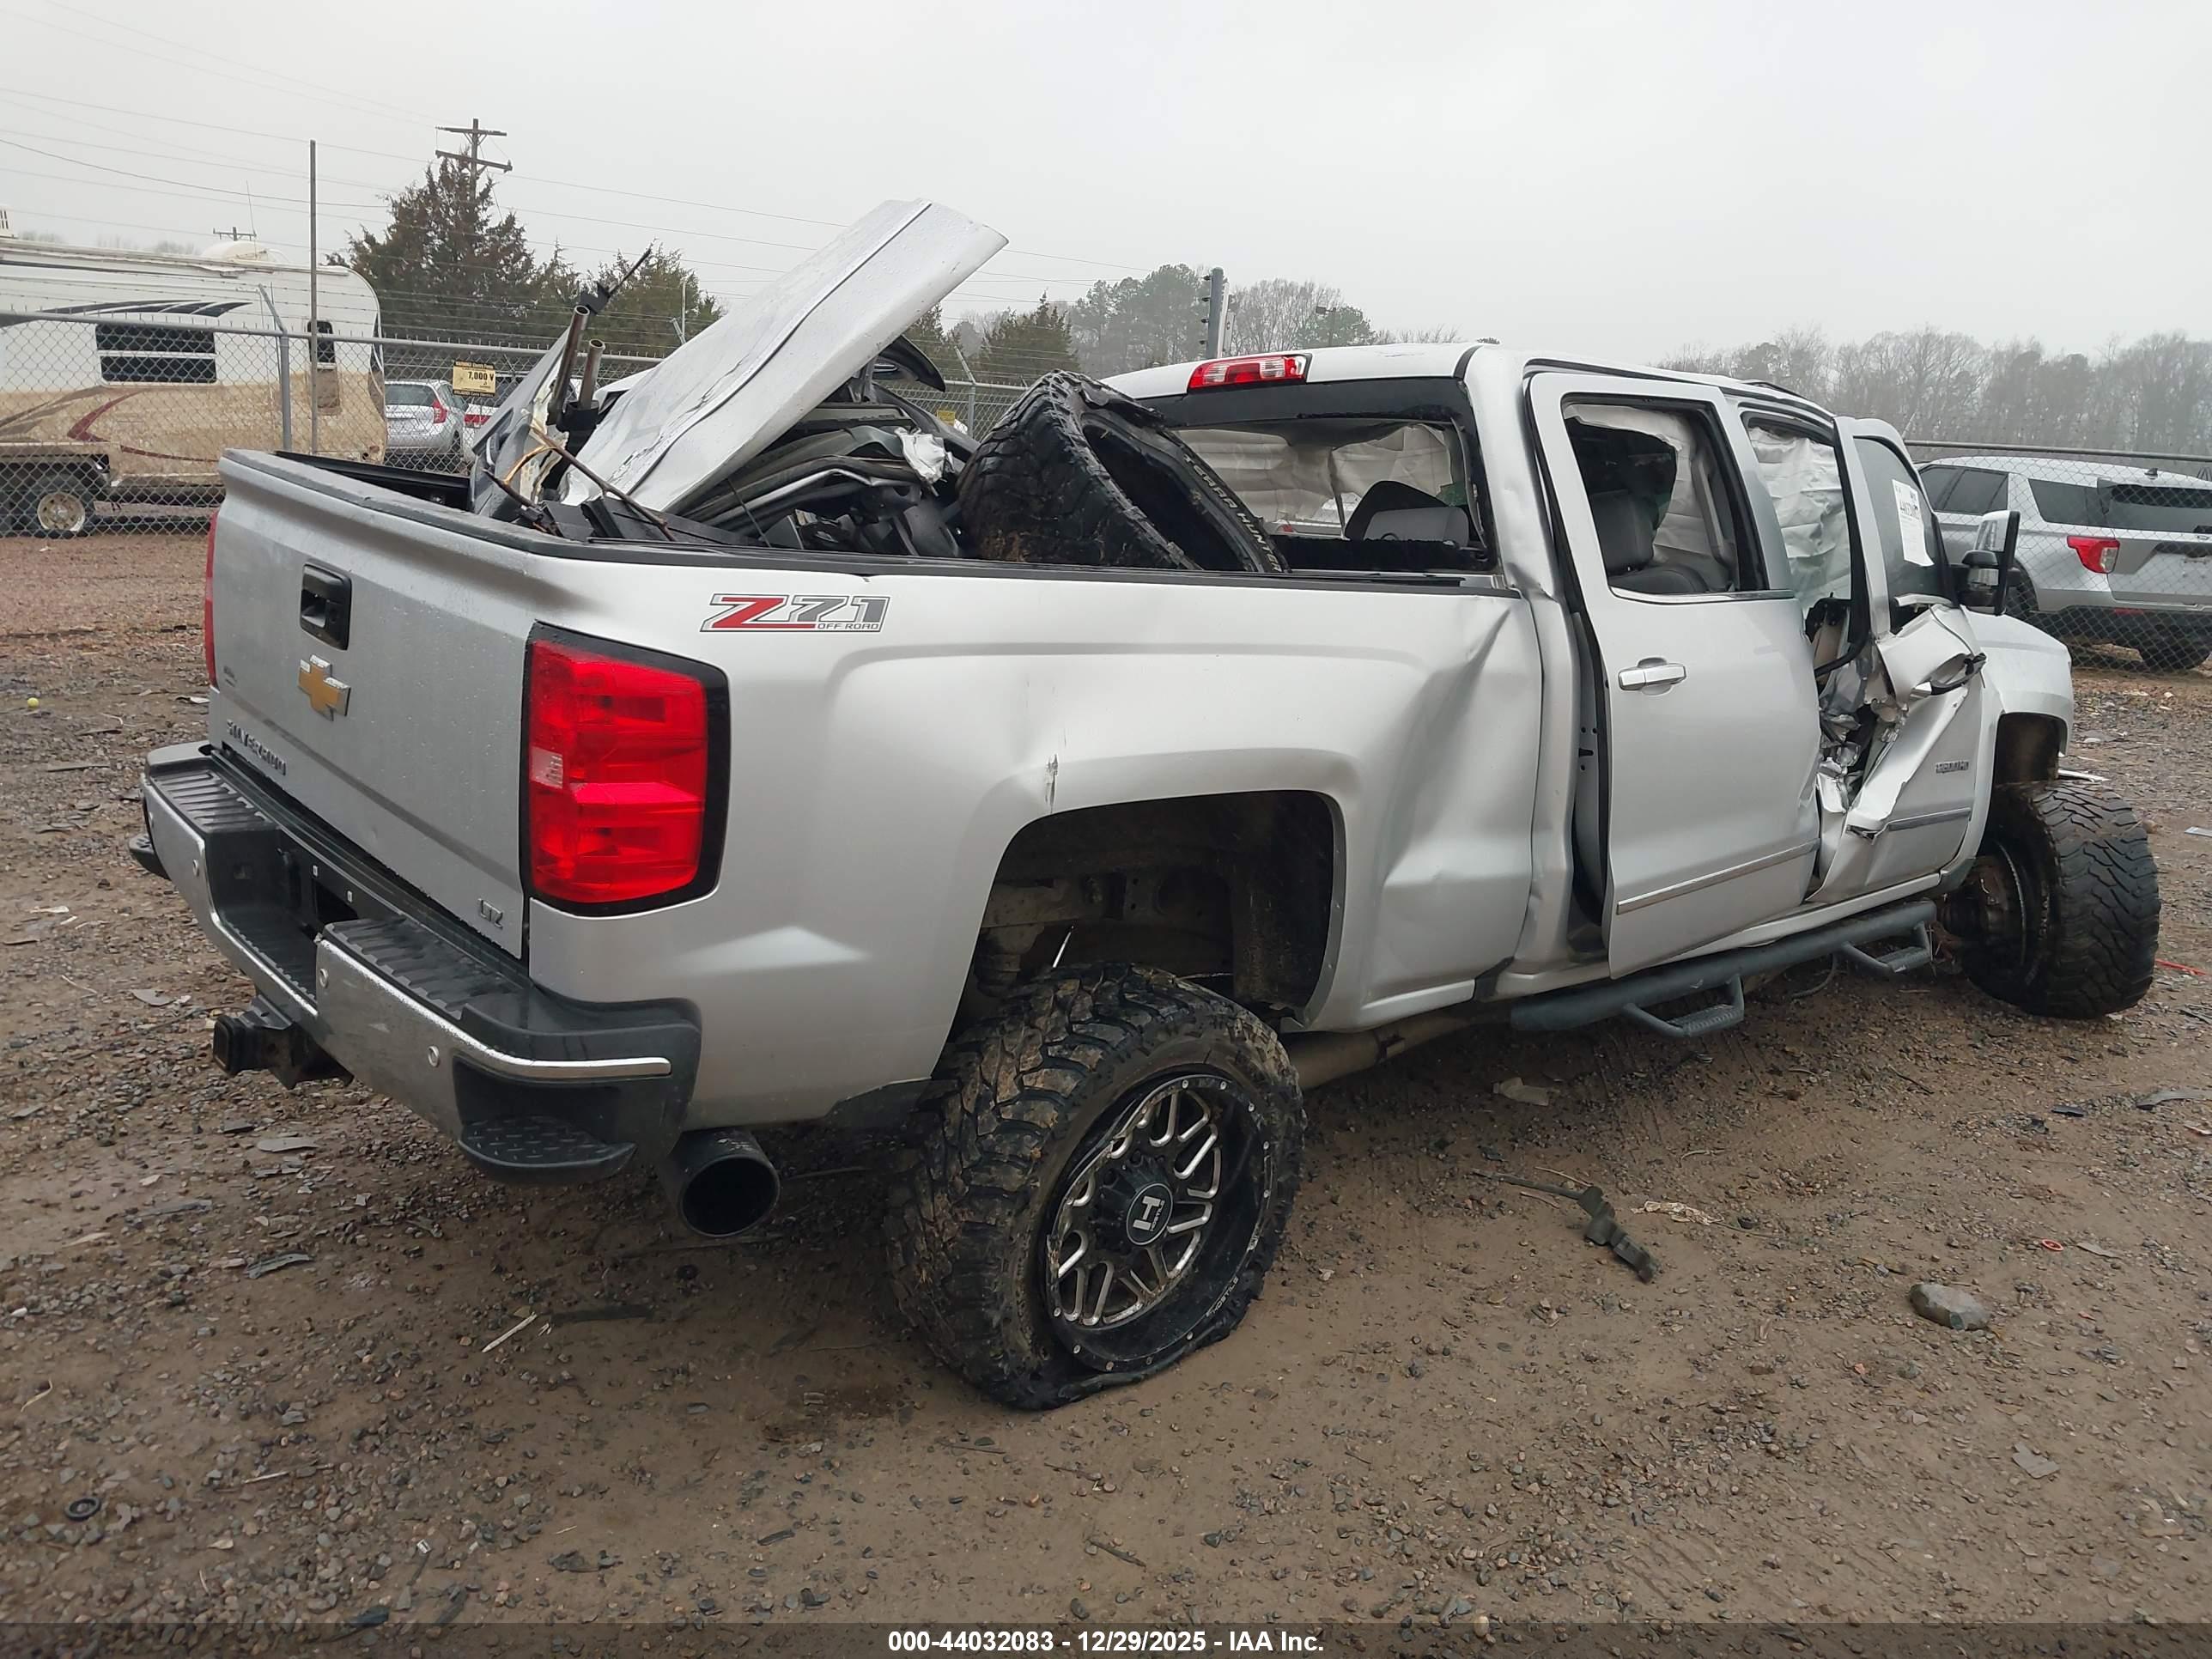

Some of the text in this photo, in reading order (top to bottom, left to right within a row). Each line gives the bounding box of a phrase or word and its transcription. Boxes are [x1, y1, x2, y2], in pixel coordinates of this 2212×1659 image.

[468, 371, 495, 381] 7,000 V
[1237, 513, 1282, 573] HUNTER
[700, 593, 890, 633] Z71
[1208, 1276, 1239, 1315] HOSTILE
